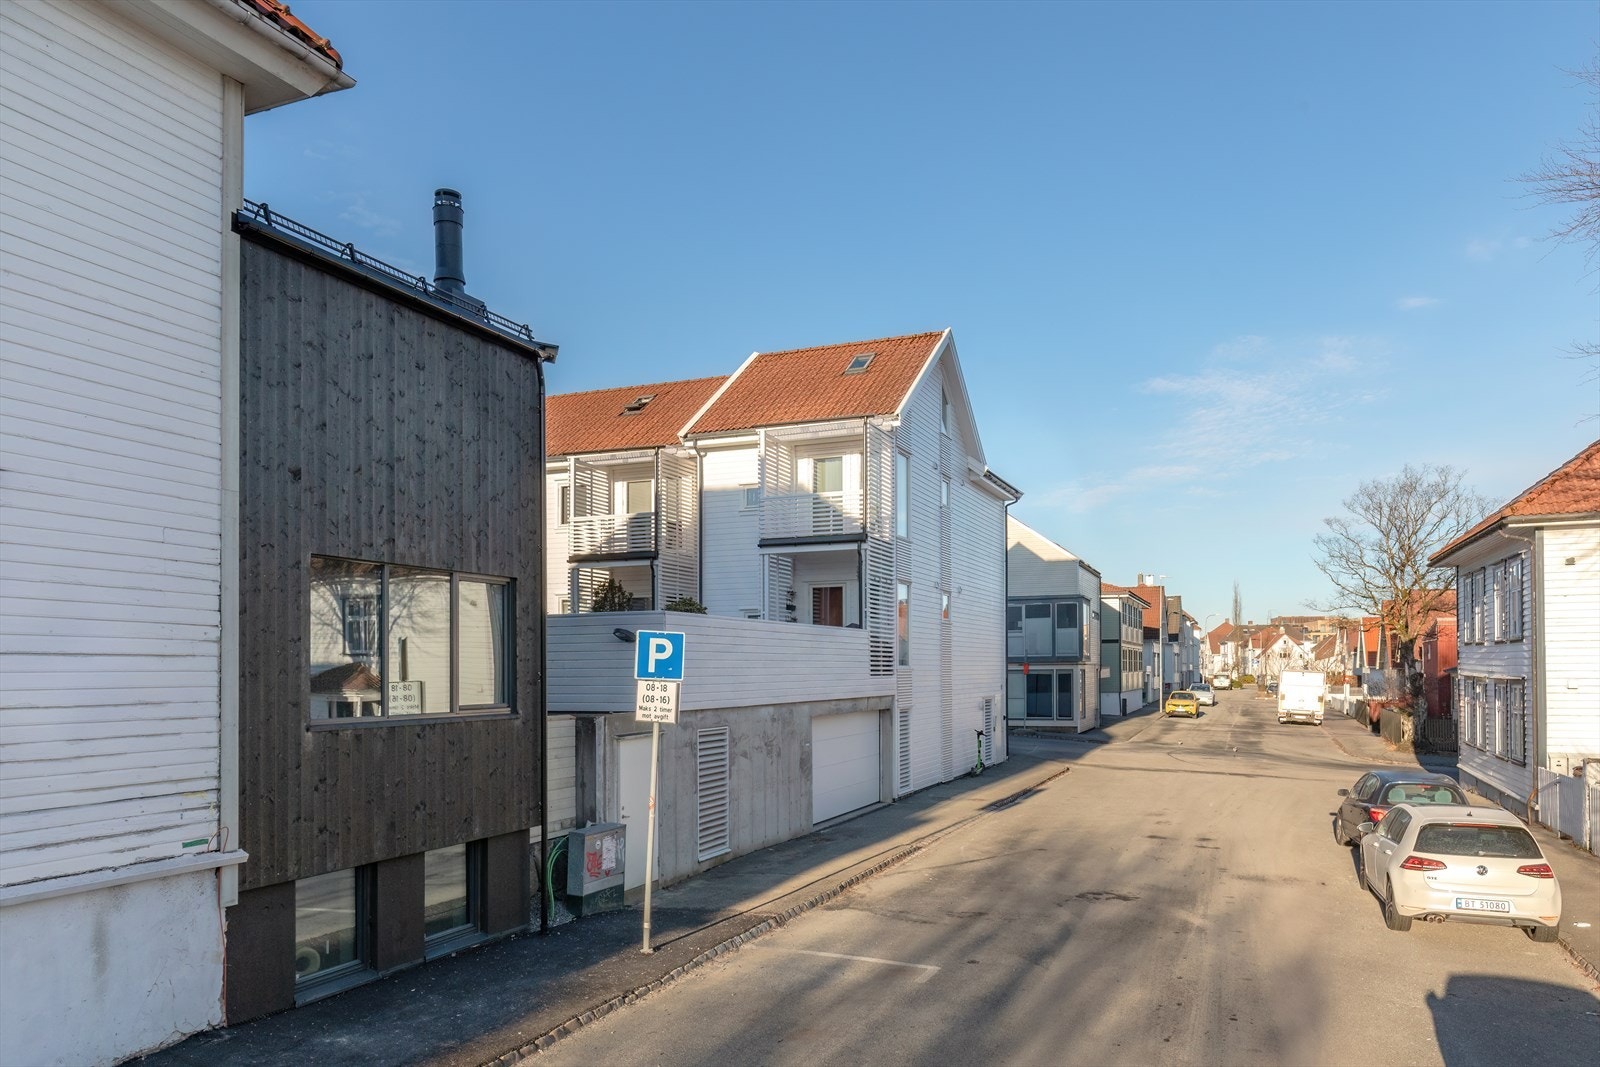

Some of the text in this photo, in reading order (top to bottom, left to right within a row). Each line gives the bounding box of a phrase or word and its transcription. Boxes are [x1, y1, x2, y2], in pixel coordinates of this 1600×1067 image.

[648, 638, 673, 672] P
[646, 684, 667, 692] 08-18
[642, 695, 670, 704] (08-16)
[654, 713, 669, 721] avgift
[1464, 899, 1506, 910] BT 51080
